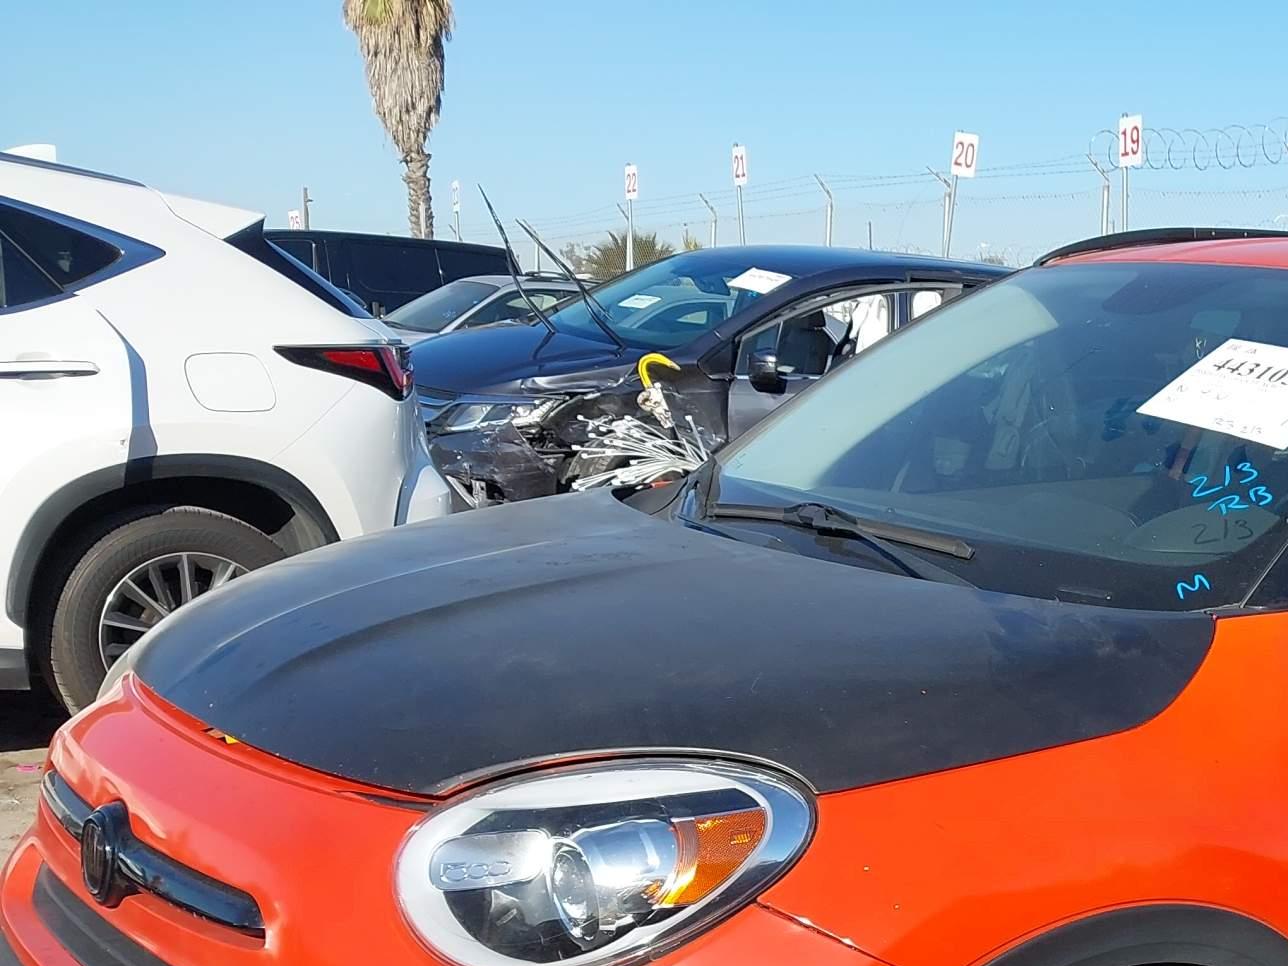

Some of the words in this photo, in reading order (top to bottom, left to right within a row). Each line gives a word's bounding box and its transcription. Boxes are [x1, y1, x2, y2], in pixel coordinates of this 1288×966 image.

[1120, 125, 1140, 157] 19
[733, 154, 746, 178] 21
[954, 141, 975, 169] 20
[626, 172, 637, 193] 22
[1176, 574, 1211, 600] M
